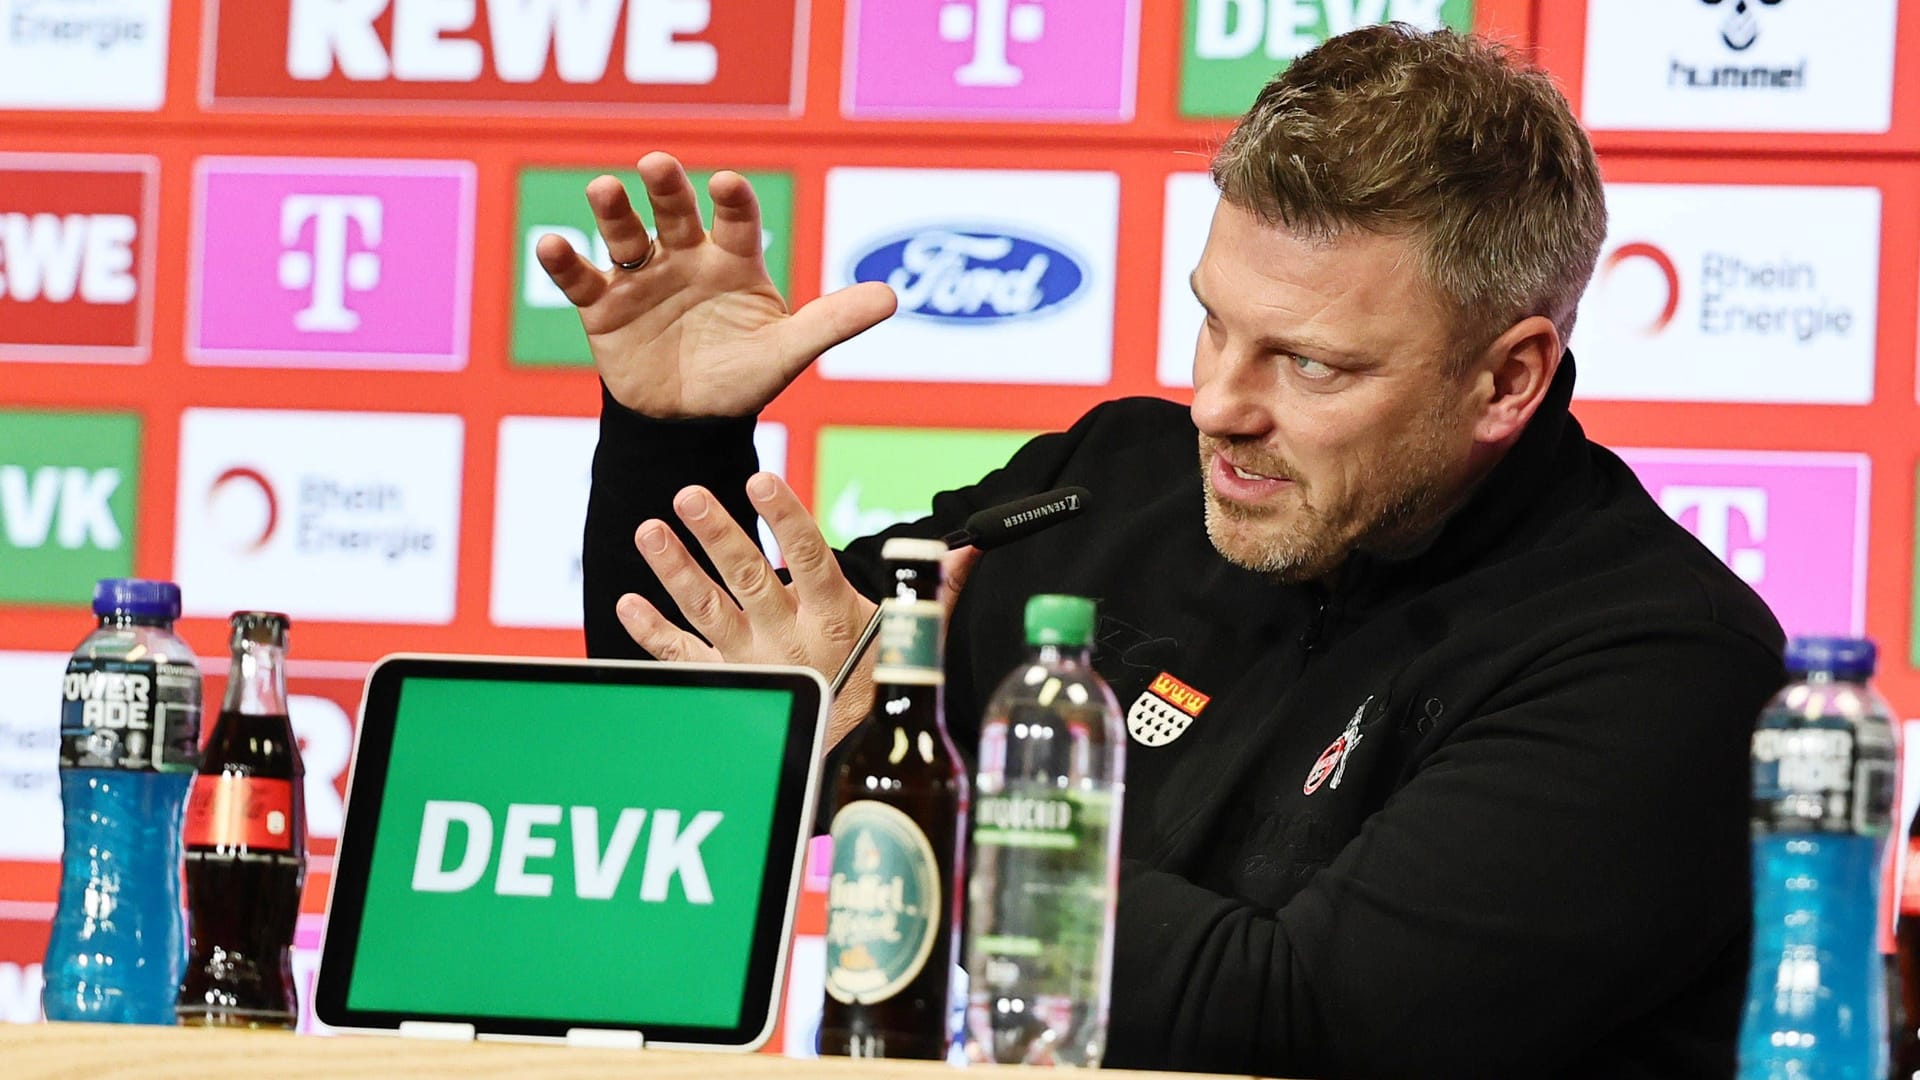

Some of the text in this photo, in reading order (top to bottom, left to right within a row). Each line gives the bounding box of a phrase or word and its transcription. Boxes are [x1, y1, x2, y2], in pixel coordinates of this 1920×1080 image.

[1668, 50, 1807, 89] hummel
[0, 212, 137, 304] WE
[888, 231, 1049, 314] Ford
[1700, 253, 1816, 288] Rhein
[1700, 294, 1853, 341] Energie
[300, 477, 402, 512] Rhein
[1003, 500, 1067, 529] SENNHEISER
[298, 514, 434, 561] Energie
[82, 700, 150, 730] ADE
[411, 800, 725, 905] DEVK
